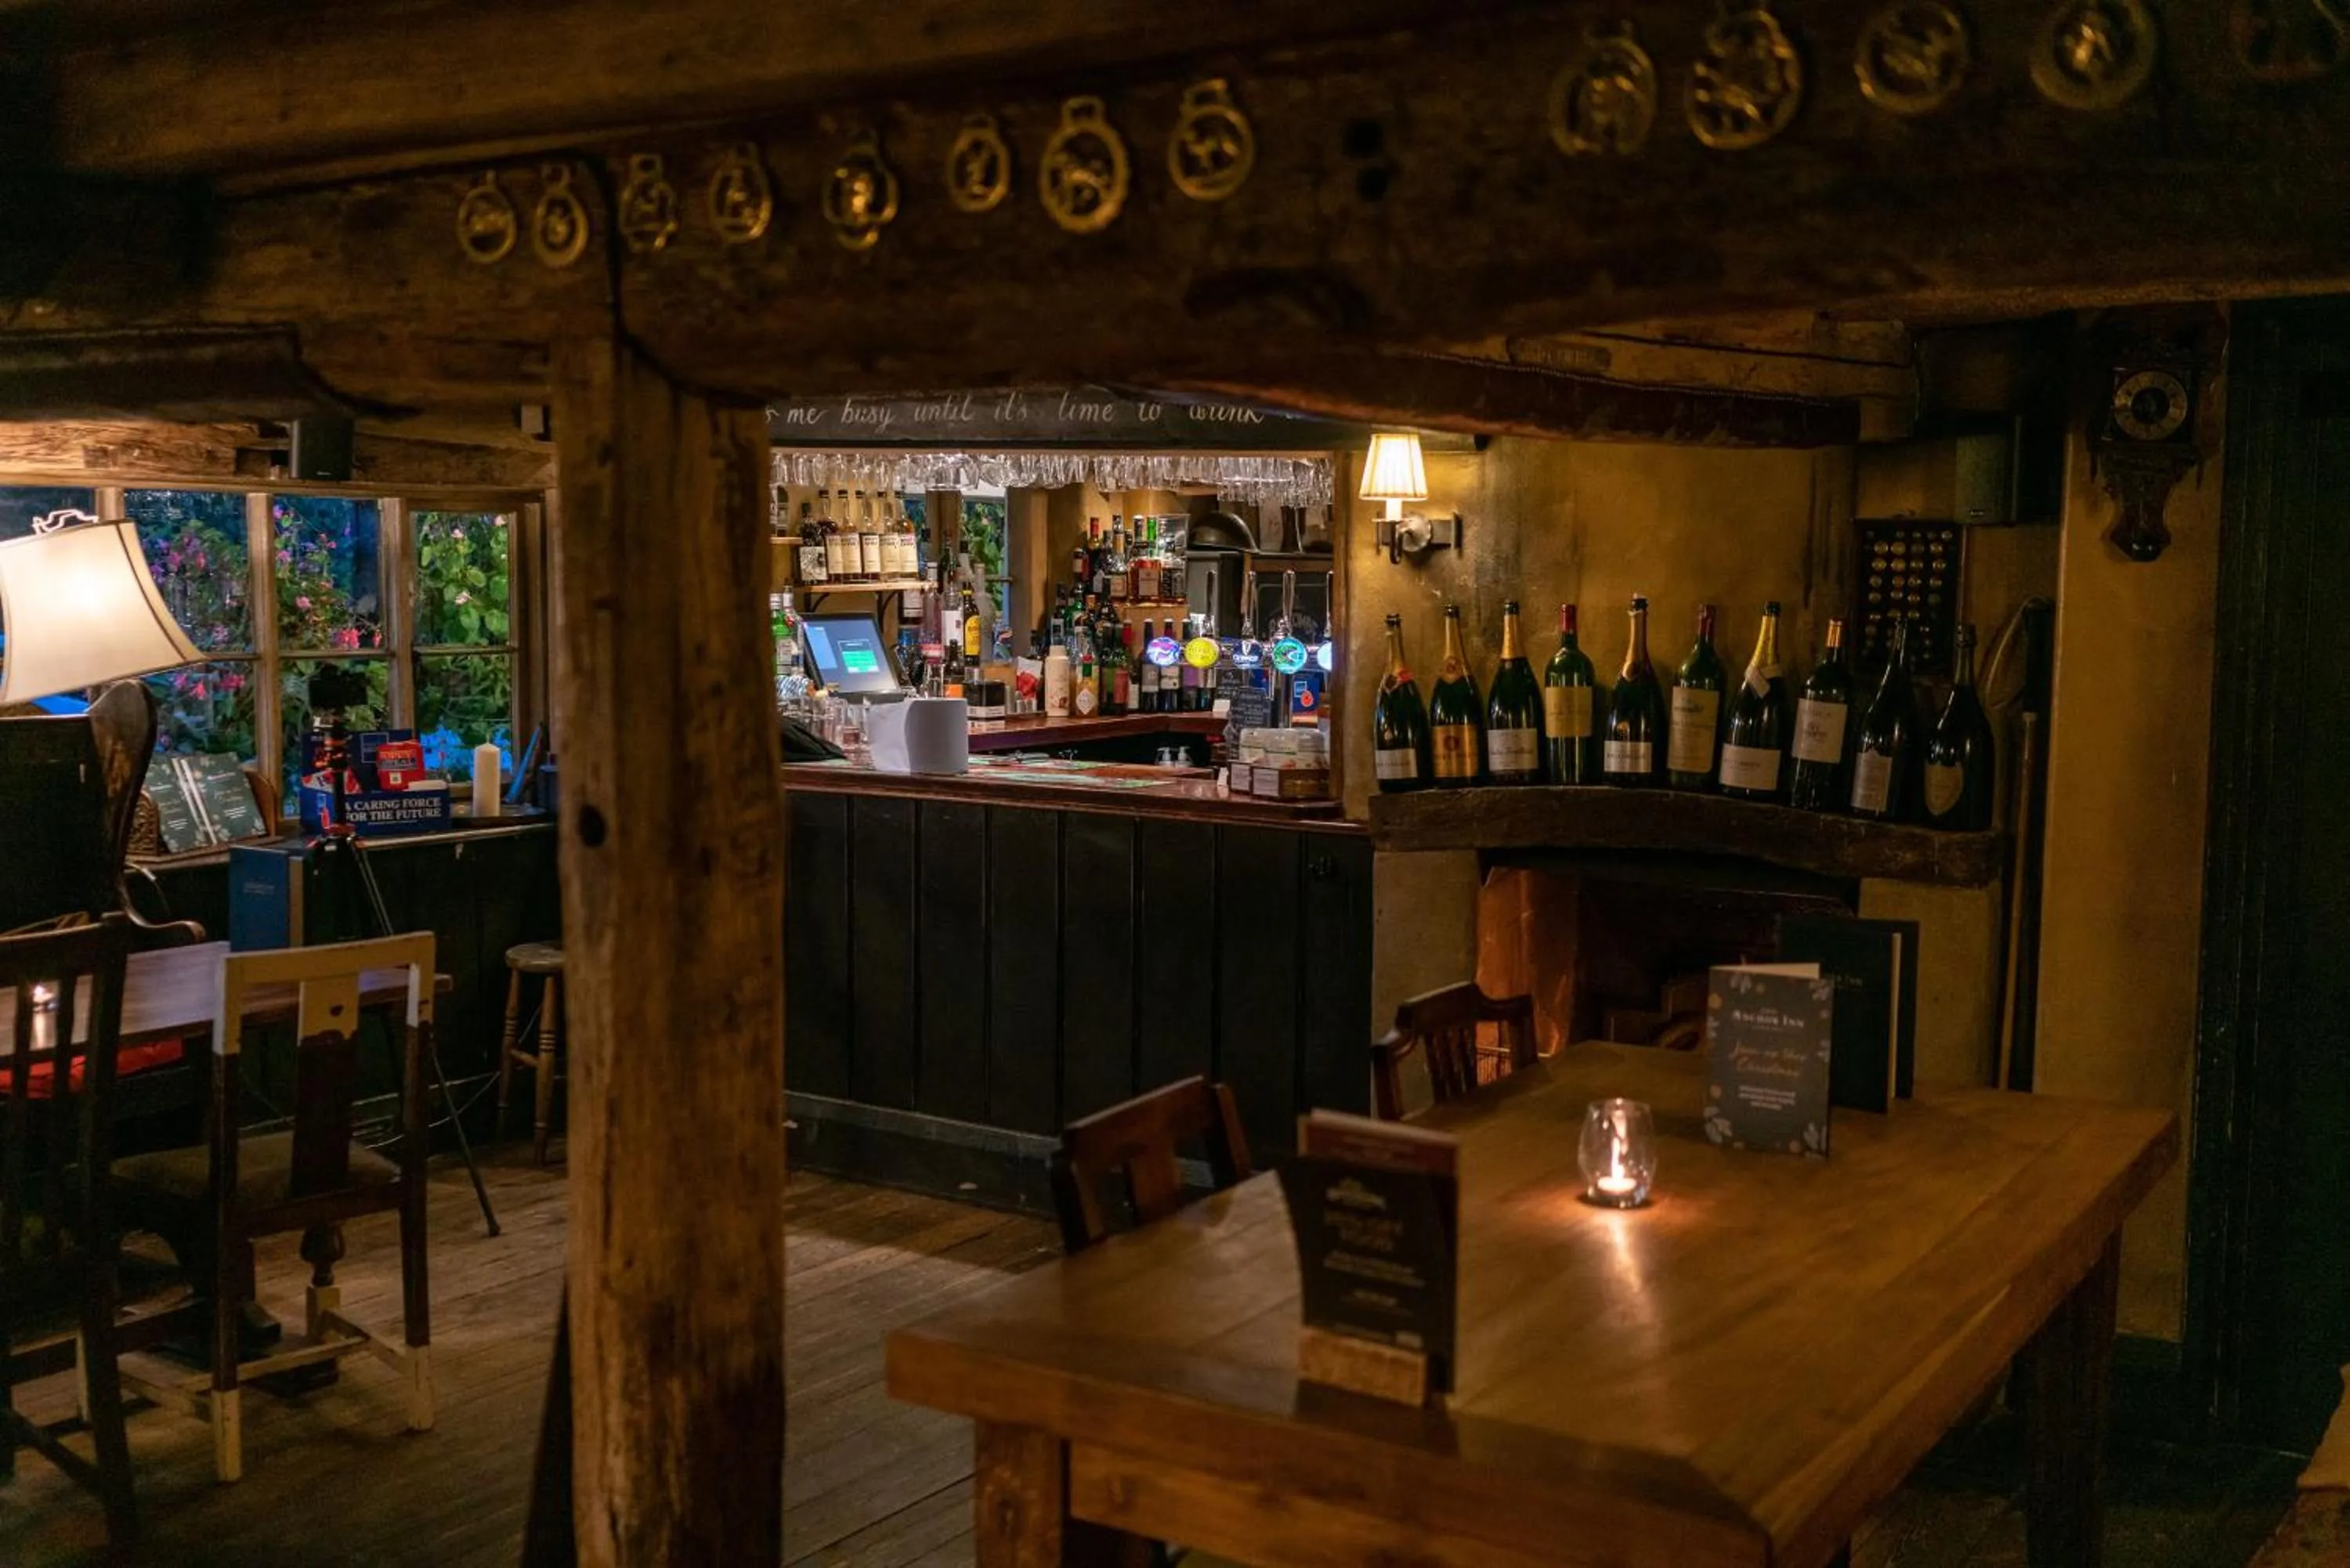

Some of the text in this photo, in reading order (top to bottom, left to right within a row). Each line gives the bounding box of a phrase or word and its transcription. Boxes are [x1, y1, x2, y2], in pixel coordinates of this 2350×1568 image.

[786, 407, 829, 425] me
[841, 398, 897, 433] busy
[913, 390, 976, 422] until
[353, 799, 400, 811] CARING
[402, 797, 442, 809] FORCE
[369, 810, 393, 821] THE
[396, 807, 442, 820] FUTURE
